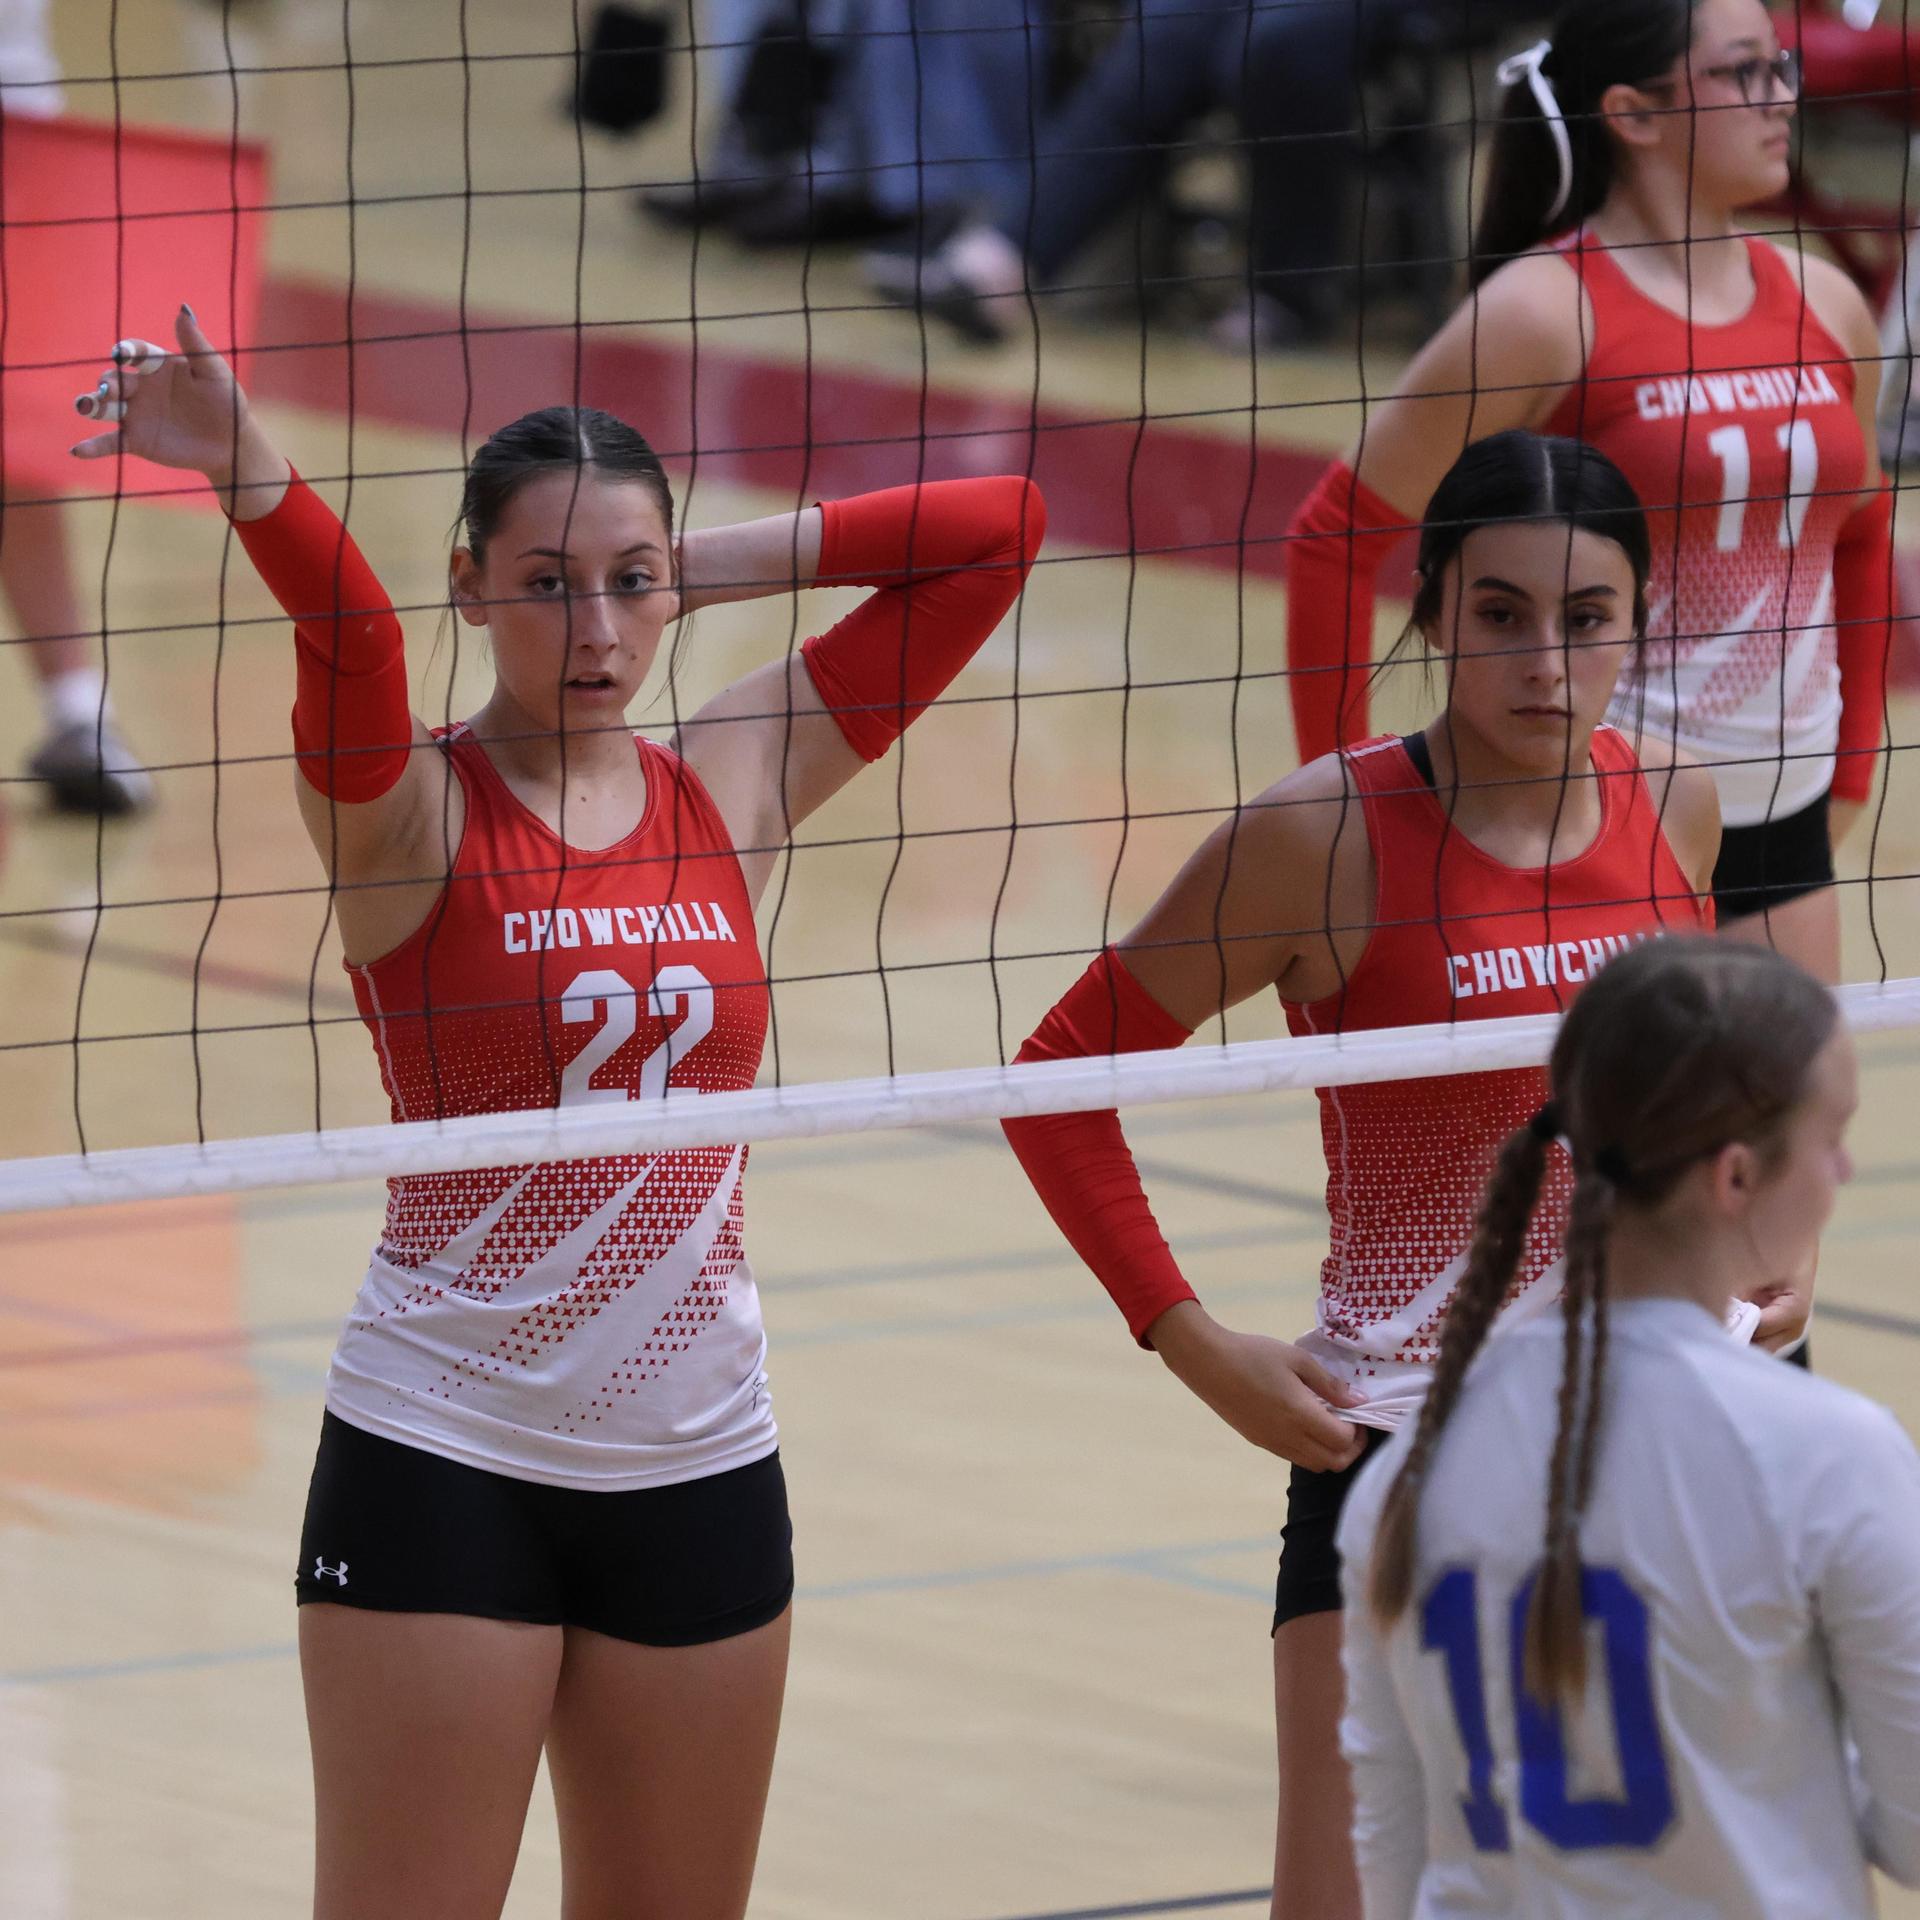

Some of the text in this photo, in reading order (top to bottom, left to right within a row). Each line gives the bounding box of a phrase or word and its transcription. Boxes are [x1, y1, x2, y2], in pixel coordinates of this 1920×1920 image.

[1635, 366, 1840, 421] CHOWCHILLA
[1708, 419, 1818, 552] 11
[504, 901, 737, 955] CHOWCHILLA
[1446, 931, 1665, 998] CHOWCHI
[559, 964, 714, 1107] 22
[1419, 1563, 1676, 1854] 10
